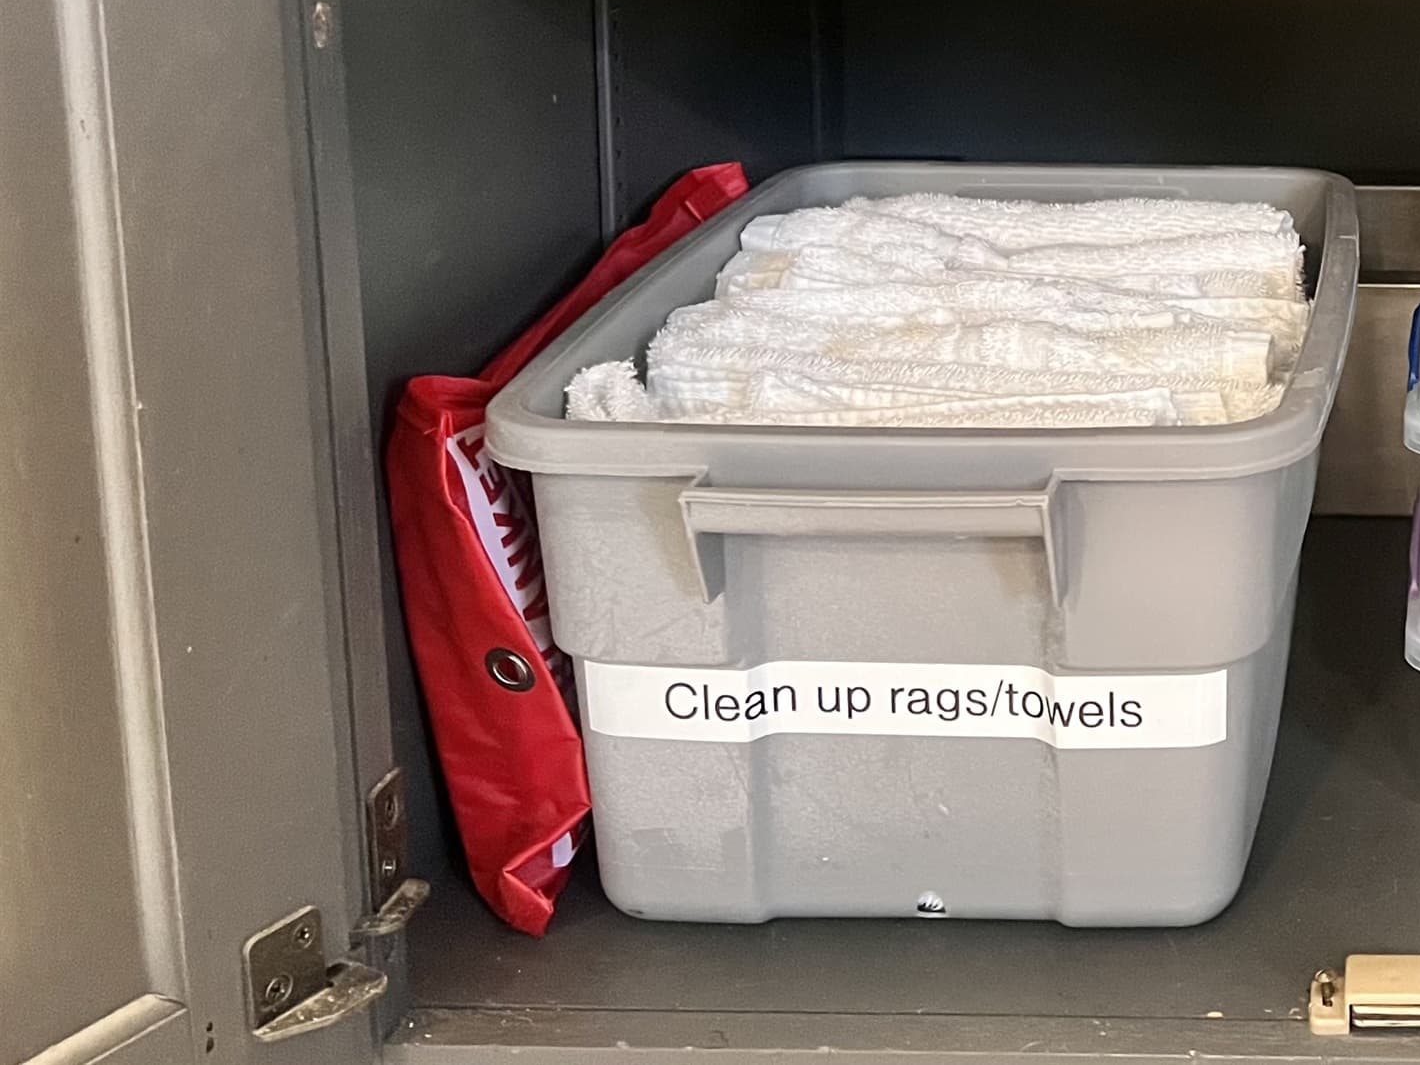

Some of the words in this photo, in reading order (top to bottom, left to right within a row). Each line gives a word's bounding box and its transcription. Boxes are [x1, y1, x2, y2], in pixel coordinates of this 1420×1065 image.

[664, 681, 798, 723] Clean
[817, 681, 872, 718] up
[889, 678, 1144, 728] rags/towels
